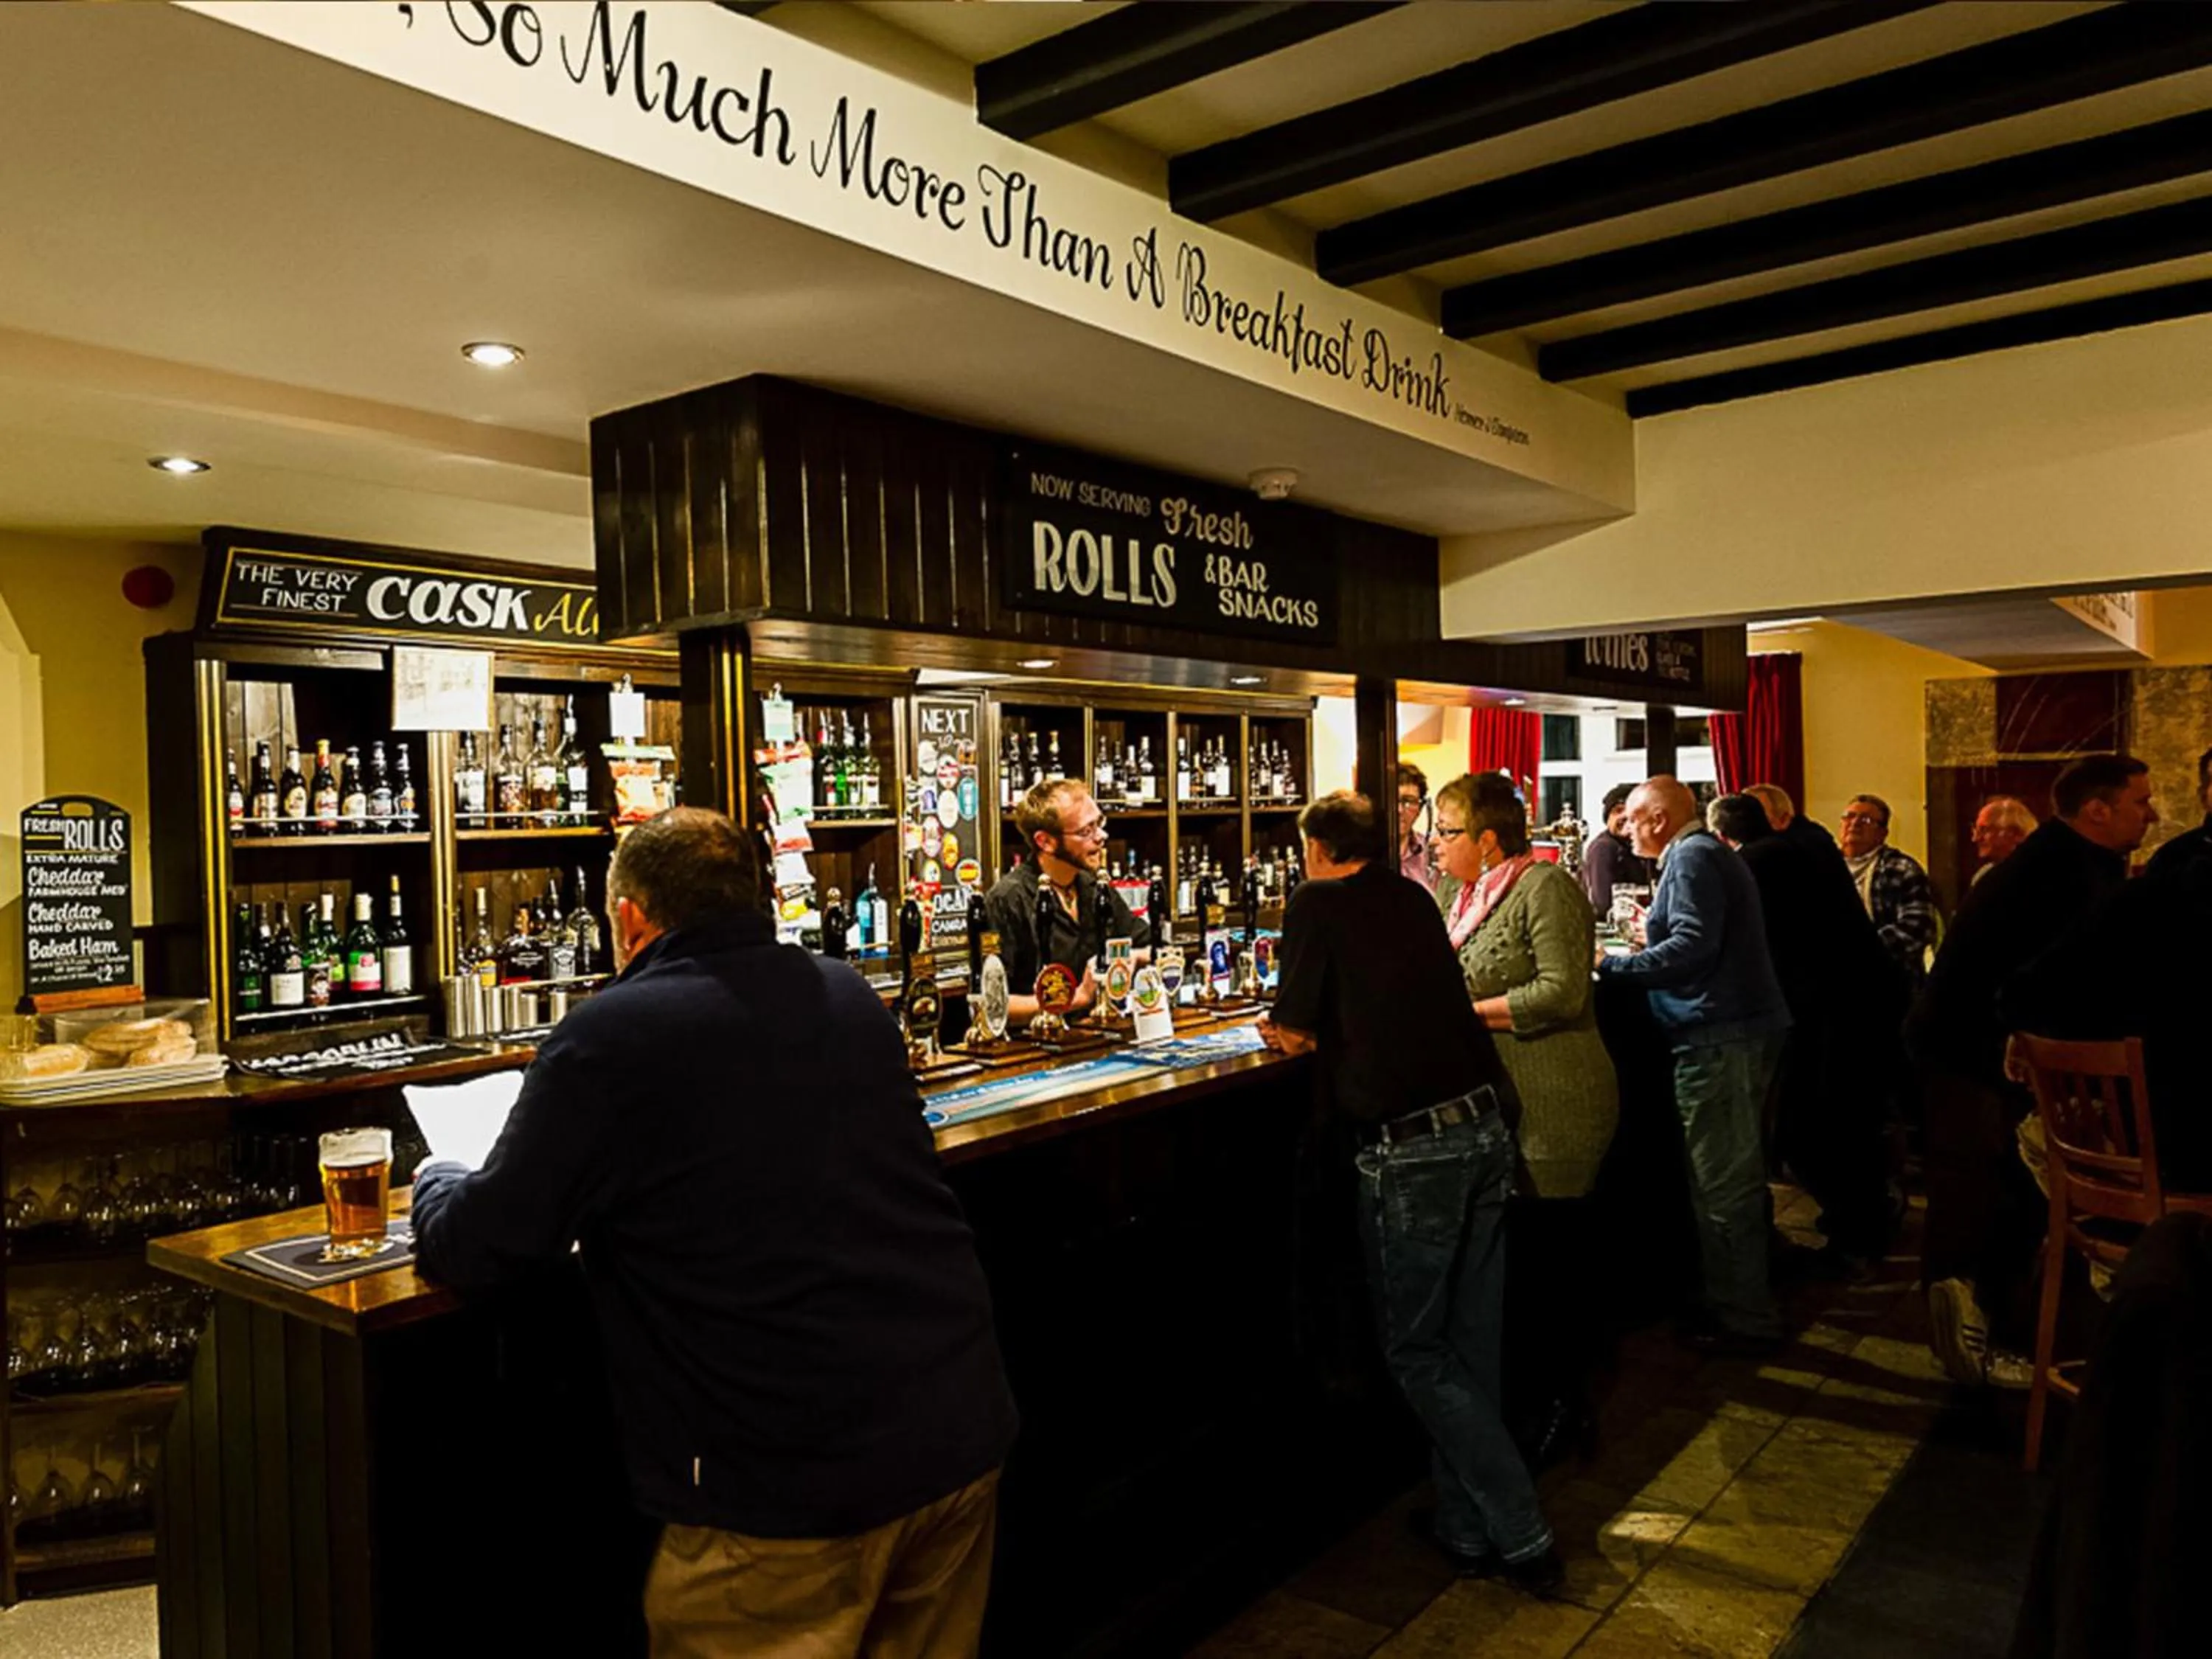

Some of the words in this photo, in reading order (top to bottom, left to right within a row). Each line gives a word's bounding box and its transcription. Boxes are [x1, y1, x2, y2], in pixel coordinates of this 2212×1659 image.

[560, 1, 796, 166] Much
[811, 96, 966, 231] More
[978, 163, 1113, 289] Than
[1126, 227, 1164, 309] A
[1176, 242, 1355, 381] Breakfast
[1361, 328, 1451, 419] Drink
[1031, 472, 1074, 501] NOW
[1077, 481, 1152, 517] SERVING
[1160, 497, 1253, 550] Fresh
[1033, 521, 1177, 608] ROLLS
[236, 563, 285, 585] THE
[295, 569, 359, 591] VERY
[533, 592, 599, 637] Al
[261, 588, 347, 613] FINEST
[1219, 588, 1319, 628] SNACKS
[922, 709, 970, 733] NEXT
[64, 818, 125, 852] ROLLS
[28, 866, 105, 886] Cheddar
[28, 902, 102, 924] Cheddar
[28, 923, 62, 934] HAND
[66, 919, 114, 933] CARVED
[28, 938, 77, 961] Baked
[80, 935, 119, 956] Ham
